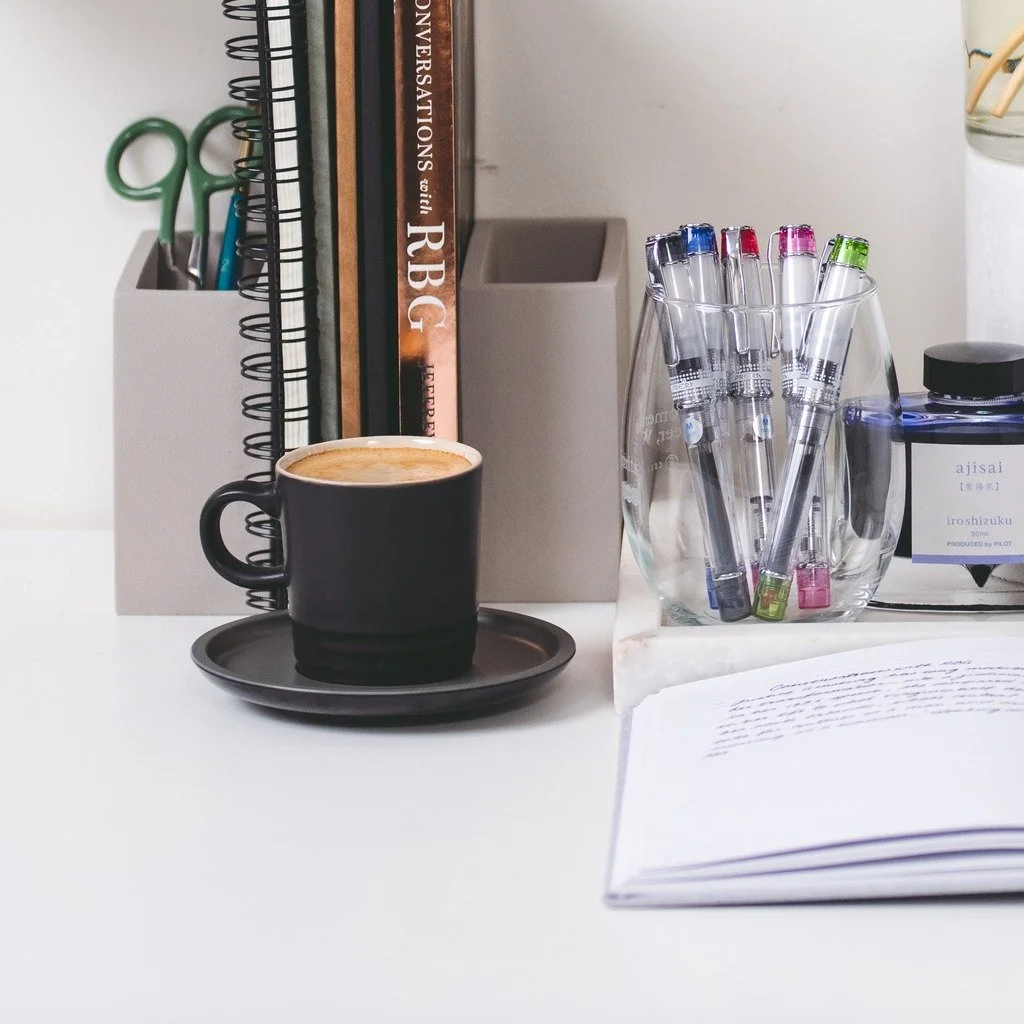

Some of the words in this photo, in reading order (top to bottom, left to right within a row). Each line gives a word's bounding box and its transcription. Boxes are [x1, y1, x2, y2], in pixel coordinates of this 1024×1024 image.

[420, 179, 432, 215] with
[406, 221, 446, 332] RBG
[956, 461, 1003, 477] ajisai
[946, 515, 1013, 526] iroshizuku
